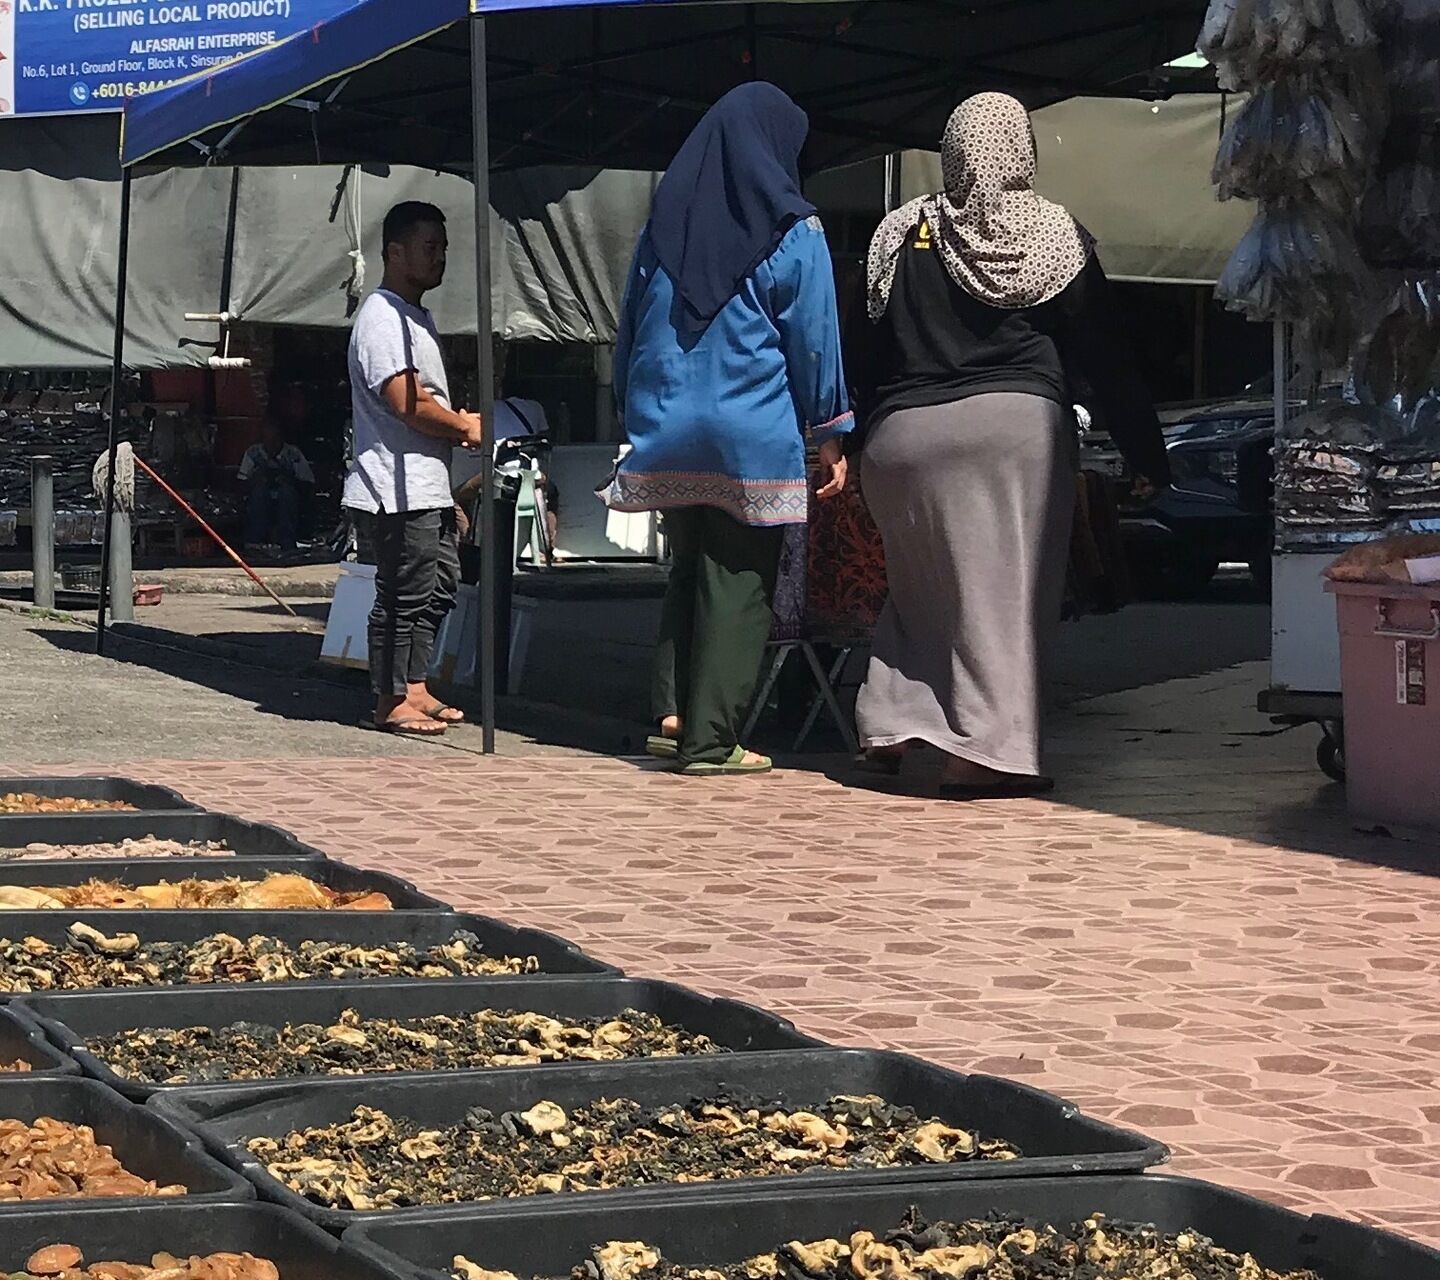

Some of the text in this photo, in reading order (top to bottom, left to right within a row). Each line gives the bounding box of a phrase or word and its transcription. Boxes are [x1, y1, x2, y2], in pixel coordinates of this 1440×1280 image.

[74, 6, 144, 33] (SELLING
[149, 2, 201, 26] LOCAL
[130, 30, 275, 54] ALFASRAH ENTERPRISE
[23, 65, 49, 78] No.6,
[51, 63, 68, 76] Lot
[70, 63, 79, 77] 1,
[81, 60, 116, 75] Ground
[118, 59, 145, 73] Floor,
[148, 56, 175, 71] Block
[177, 55, 188, 70] K,
